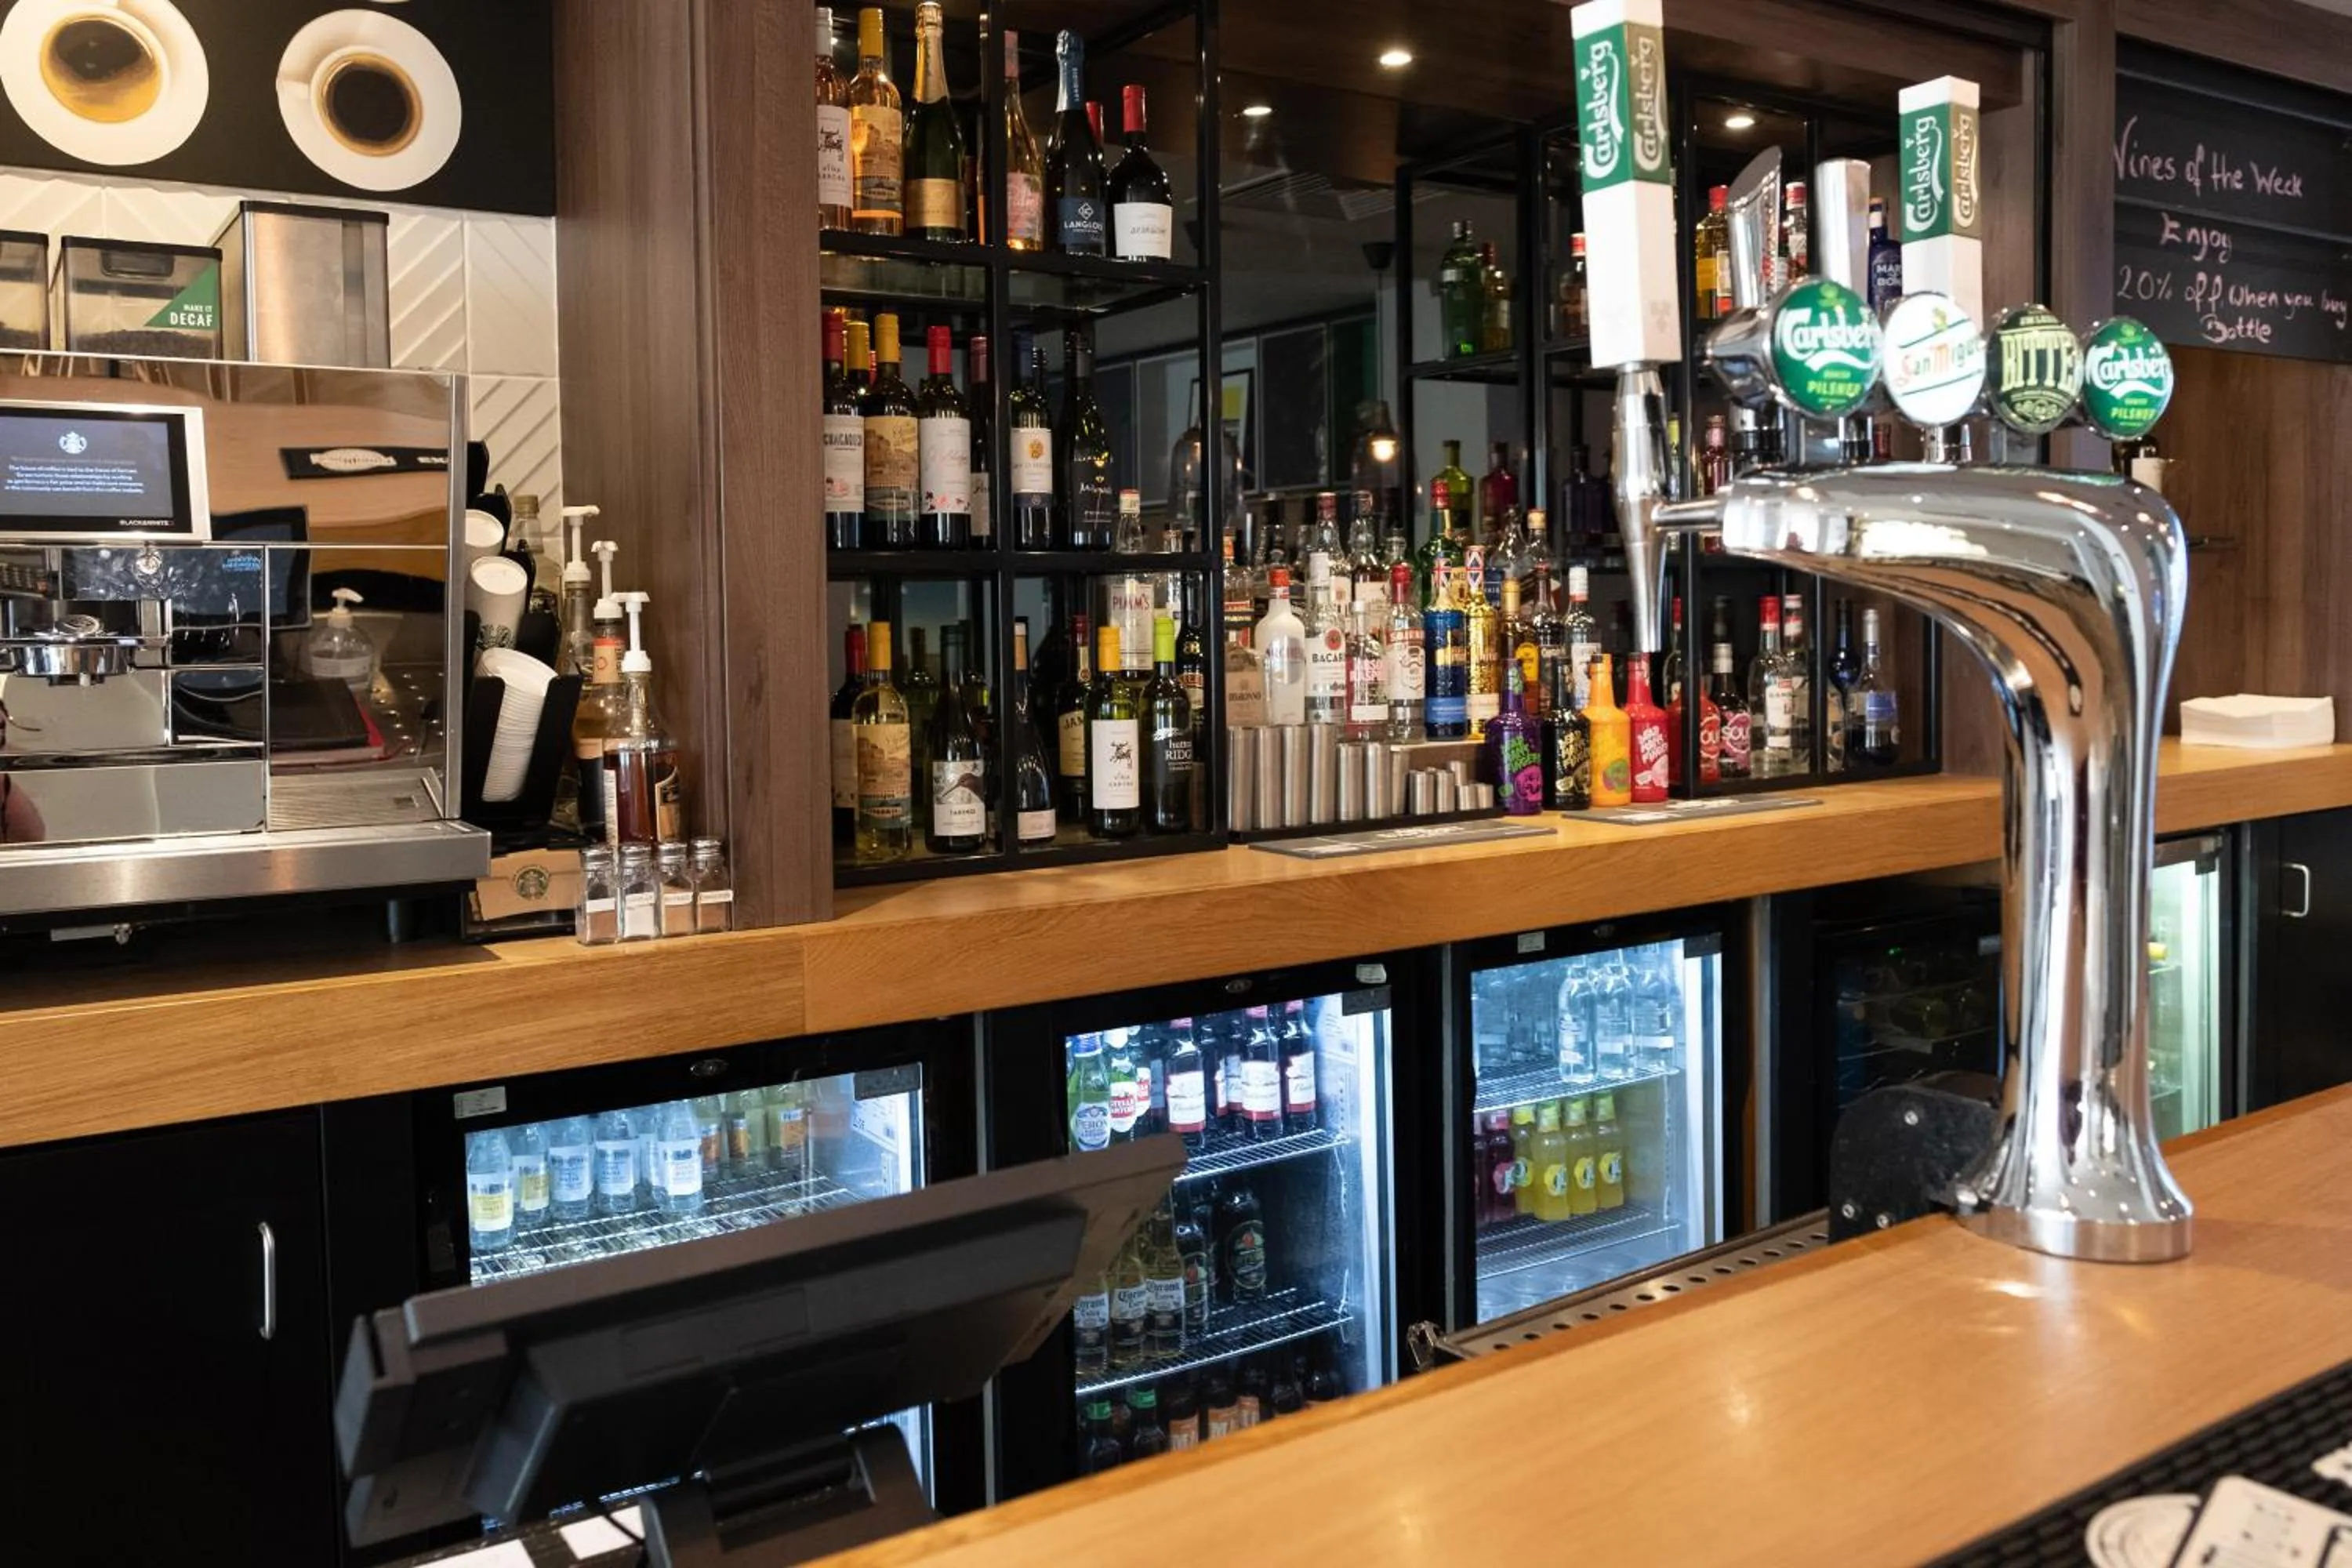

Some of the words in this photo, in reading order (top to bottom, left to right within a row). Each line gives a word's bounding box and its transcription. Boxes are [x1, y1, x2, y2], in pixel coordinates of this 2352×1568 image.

[1581, 40, 1624, 180] Carlsberg
[1630, 36, 1668, 172] Carlsberg
[1905, 115, 1944, 233] Carlsberg
[1952, 113, 1978, 228] Carlsberg
[2185, 143, 2205, 198] of
[2211, 151, 2244, 191] the
[2250, 162, 2303, 198] Week
[2160, 212, 2233, 263] Enjoy
[170, 311, 212, 327] DECAF
[2117, 265, 2172, 302] 20%
[2184, 271, 2223, 313] off
[2228, 284, 2278, 308] When
[2320, 289, 2348, 330] buy
[1777, 304, 1882, 362] Carlsber
[2200, 313, 2272, 343] Bottle
[2000, 329, 2084, 396] BITTE
[2085, 340, 2171, 390] Carlsber
[1312, 652, 1344, 663] BACAR
